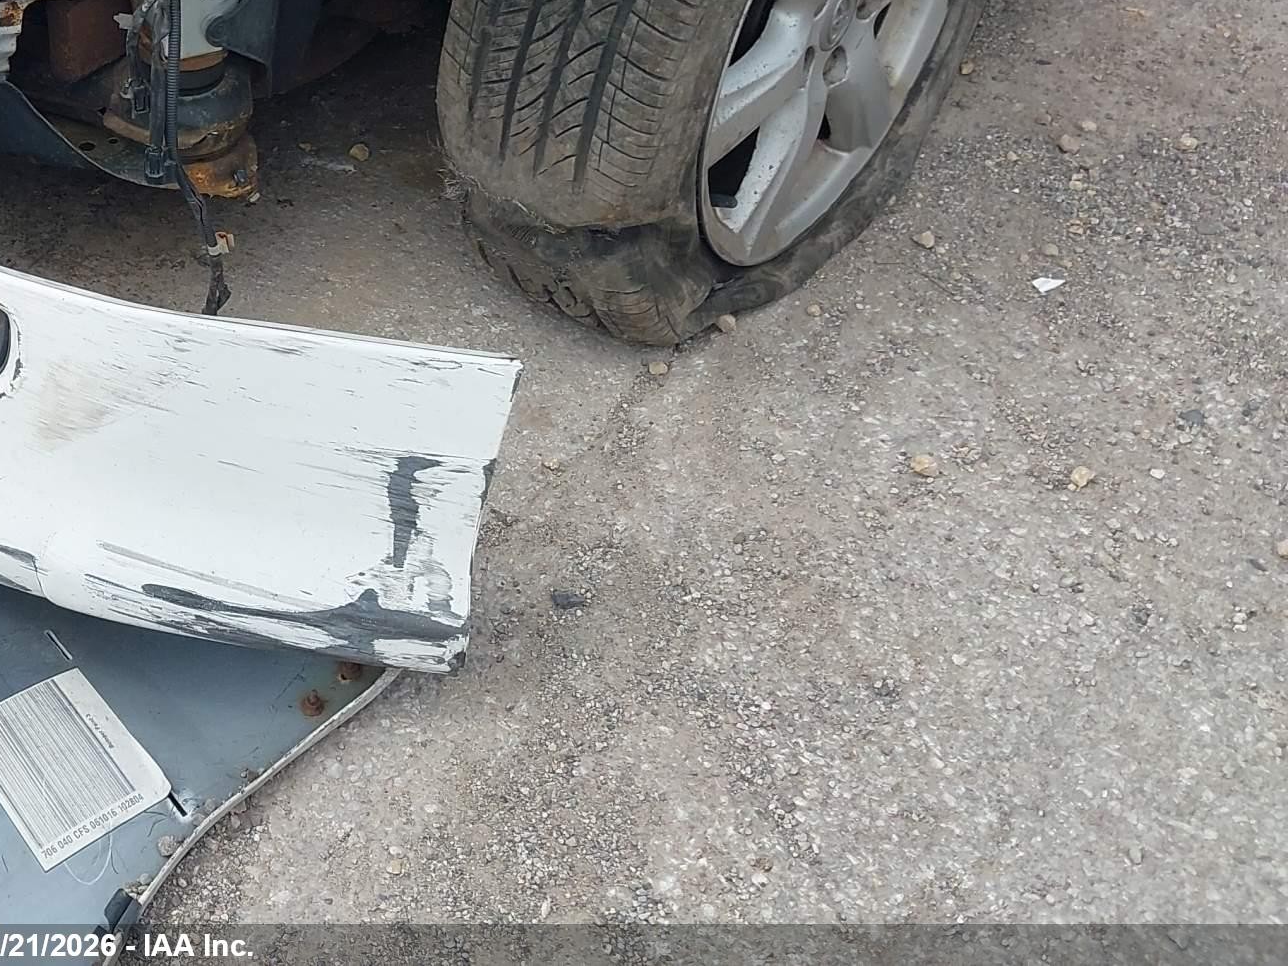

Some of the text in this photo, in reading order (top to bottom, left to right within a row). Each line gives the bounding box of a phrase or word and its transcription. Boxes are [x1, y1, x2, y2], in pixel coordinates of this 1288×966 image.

[41, 845, 58, 859] 706
[57, 835, 74, 849] 040
[73, 824, 90, 840] CFS
